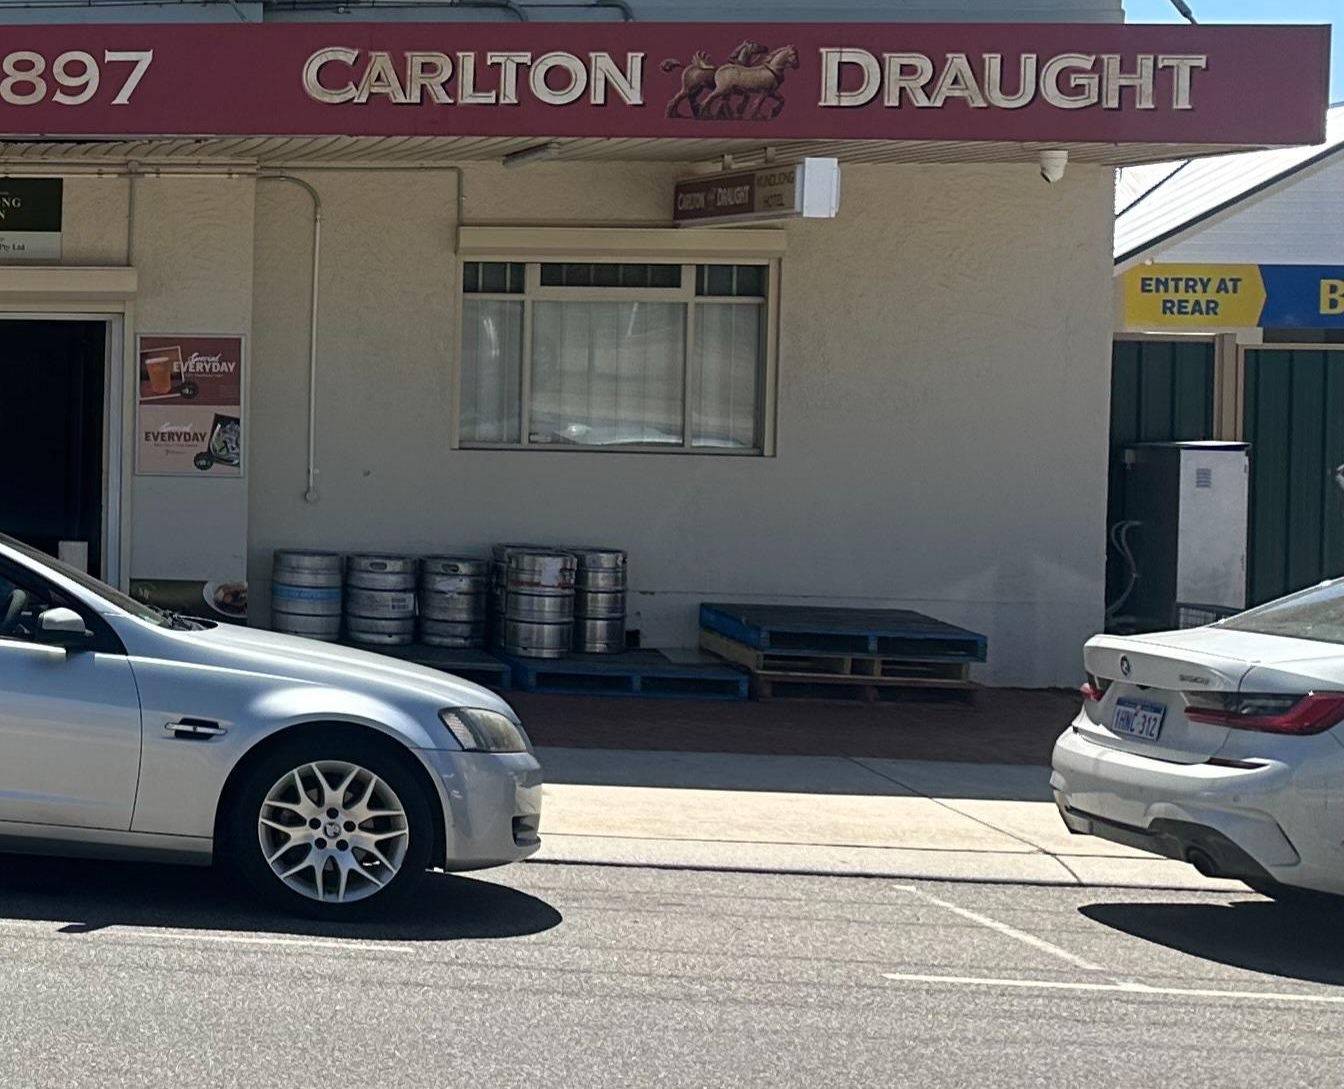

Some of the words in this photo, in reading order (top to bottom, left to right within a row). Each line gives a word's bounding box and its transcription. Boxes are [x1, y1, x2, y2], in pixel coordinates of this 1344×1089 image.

[301, 47, 645, 107] CARLTON
[818, 47, 1210, 110] DRAUGHT
[1140, 277, 1212, 294] ENTRY
[1216, 277, 1242, 294] AT
[1162, 299, 1219, 316] REAR
[173, 361, 236, 372] EVERYDAY
[144, 431, 207, 442] EVERYDAY
